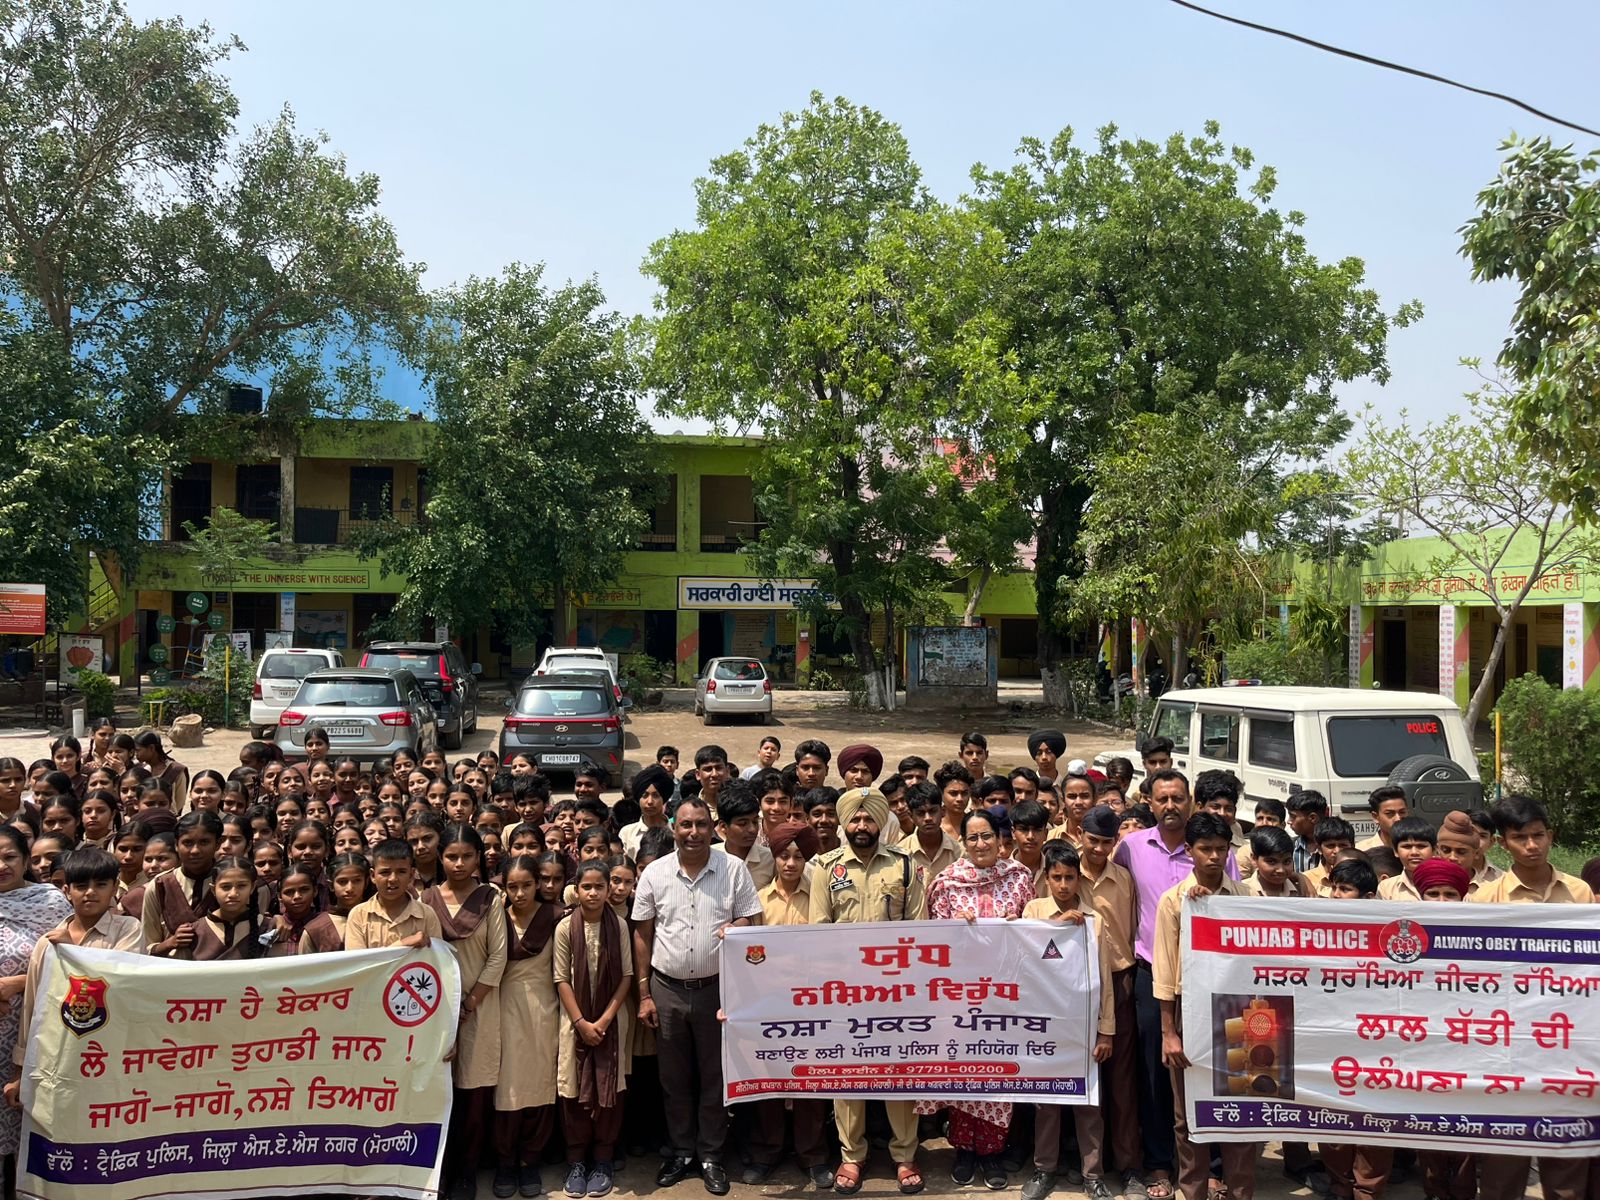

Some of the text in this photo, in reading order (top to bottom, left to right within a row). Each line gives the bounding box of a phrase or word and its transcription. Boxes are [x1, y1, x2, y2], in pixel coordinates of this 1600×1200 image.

[244, 574, 262, 583] THE
[264, 574, 306, 583] UNIVERSE
[309, 574, 331, 583] WITH
[333, 574, 367, 584] SCIENCE
[686, 582, 741, 602] ਸਰਕਾਰੀ
[743, 583, 776, 602] ਹਾਈ
[1406, 722, 1438, 734] POLICE
[1220, 926, 1369, 950] PUNJAB POLICE
[1434, 936, 1483, 950] ALWAYS
[1486, 937, 1517, 951] OBEY
[1520, 938, 1572, 953] TRAFFIC
[859, 937, 953, 975] ਯੁੱਧ
[791, 977, 1021, 1006] ਨਸ਼ਿਆ ਵਿਰੁੱਧ
[1253, 966, 1310, 987] ਸੜਕ
[1320, 961, 1424, 993] ਸੁਰੱਖਿਆ
[1434, 963, 1502, 994] ਜੀਵਨ
[167, 987, 354, 1024] ਨਸ਼ਾ ਹੈ ਬੇਕਾਰ
[761, 1007, 1051, 1039] ਨਸ਼ਾ ਮੁਕਤ ਪੰਜਾਬ
[1355, 1008, 1574, 1049] ਲਾਲ ਬੱਤੀ ਦੀ
[80, 1027, 415, 1077] ਲੈ ਜਾਵੇਗਾ ਤੁਹਾਡੀ ਜਾਨ !
[755, 1039, 1057, 1062] ਬਣਾਉਣ ਲਈ ਪੰਜਾਬ ਪੁਲਿਸ ਨੂੰ ਸਹਿਯੋਗ ਦਿਓ
[842, 1065, 879, 1075] ਲਾਈਨ
[906, 1065, 1004, 1074] 97791-00200
[853, 1080, 868, 1089] ਨਗਰ
[1035, 1081, 1050, 1090] ਨਗਰ
[1331, 1055, 1467, 1097] ਉਲੰਘਣਾ
[1483, 1074, 1525, 1095] ਨਾ
[308, 1076, 399, 1113] ਤਿਆਗੋ
[1307, 1107, 1354, 1128] ਪੁਲਿਸ,
[1404, 1114, 1484, 1136] ਐਸ.ਏ.ਐਸ
[1489, 1122, 1528, 1136] ਨਗਰ
[1533, 1117, 1595, 1140] (ਮੋਹਾਲੀ)
[146, 1141, 193, 1169] ਪੁਲਿਸ,
[243, 1130, 319, 1157] ਐਸ.ਏ.ਐਸ
[325, 1136, 358, 1153] ਨਗਰ
[362, 1129, 418, 1158] (ਮੋਹਾਲੀ)
